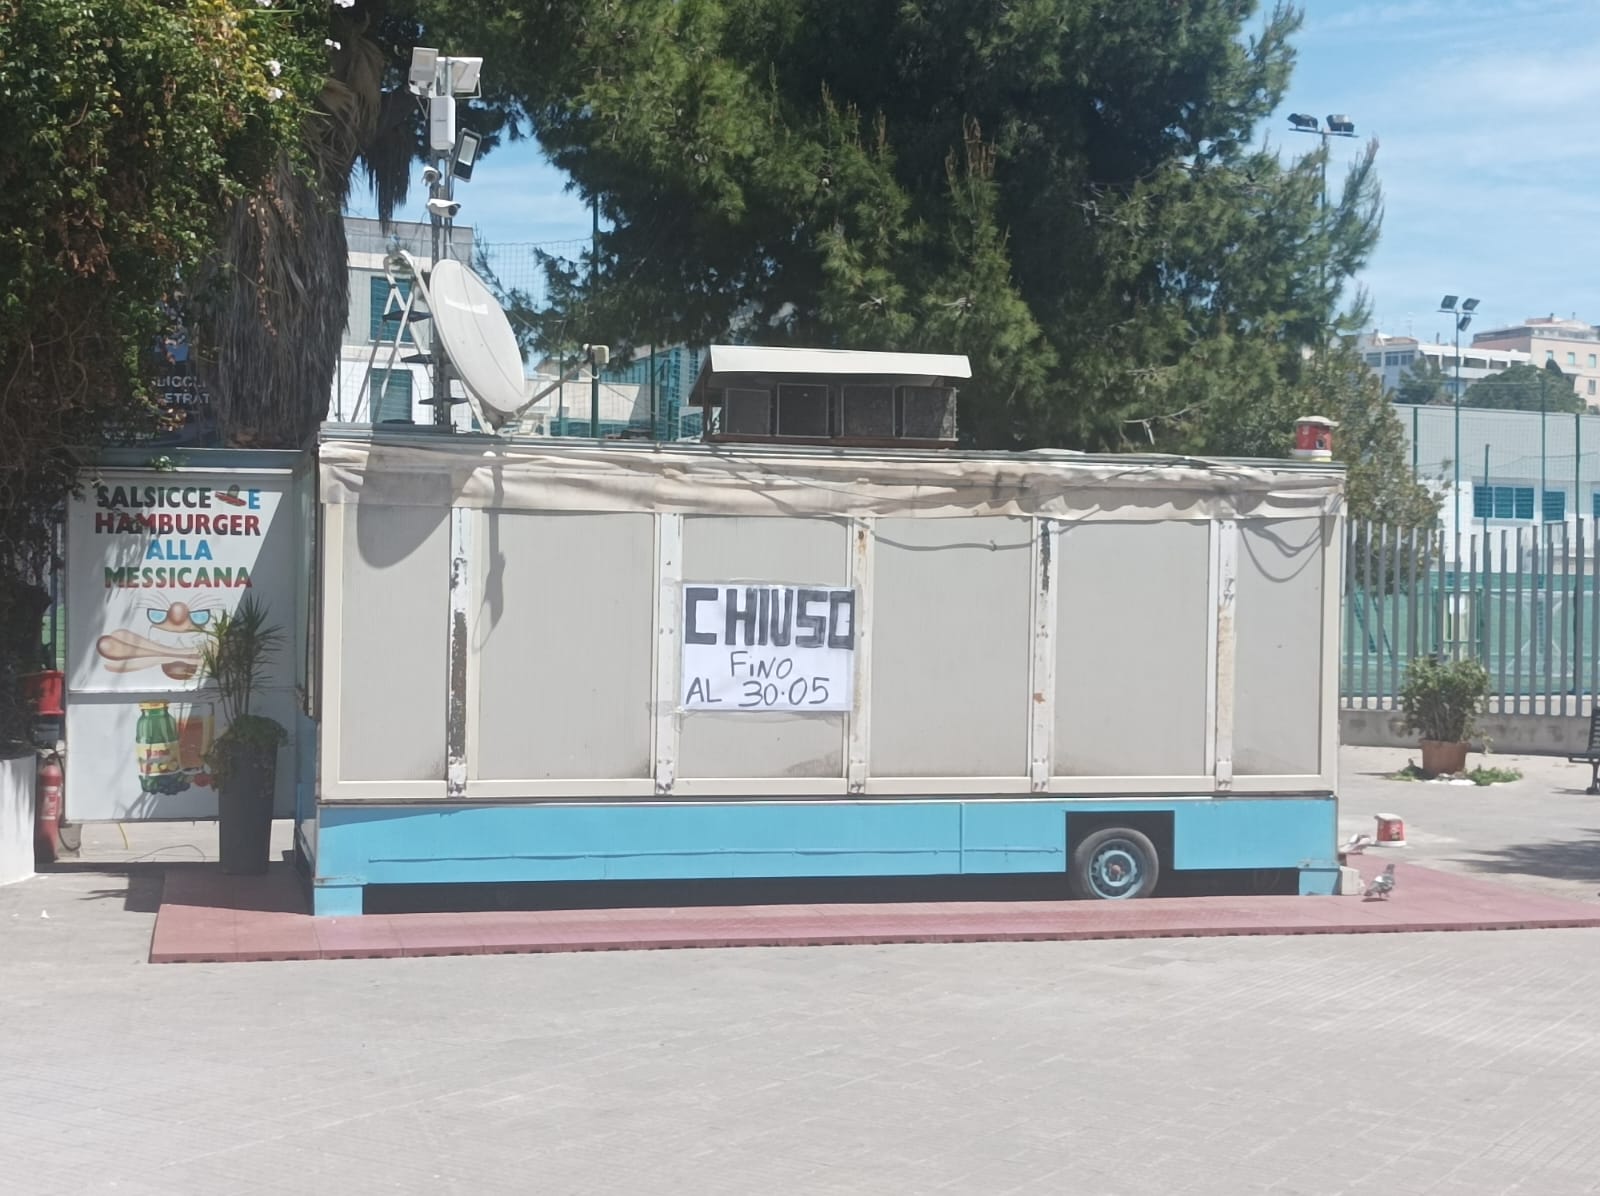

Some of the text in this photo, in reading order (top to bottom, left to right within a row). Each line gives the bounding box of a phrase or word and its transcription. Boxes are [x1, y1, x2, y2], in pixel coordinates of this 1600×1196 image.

[97, 485, 261, 509] SALSICCE E
[95, 513, 261, 536] HAMBURGER
[145, 539, 213, 560] ALLA
[104, 566, 253, 589] MESSICANA
[685, 587, 856, 650] CHIUSO
[686, 677, 723, 705] AL
